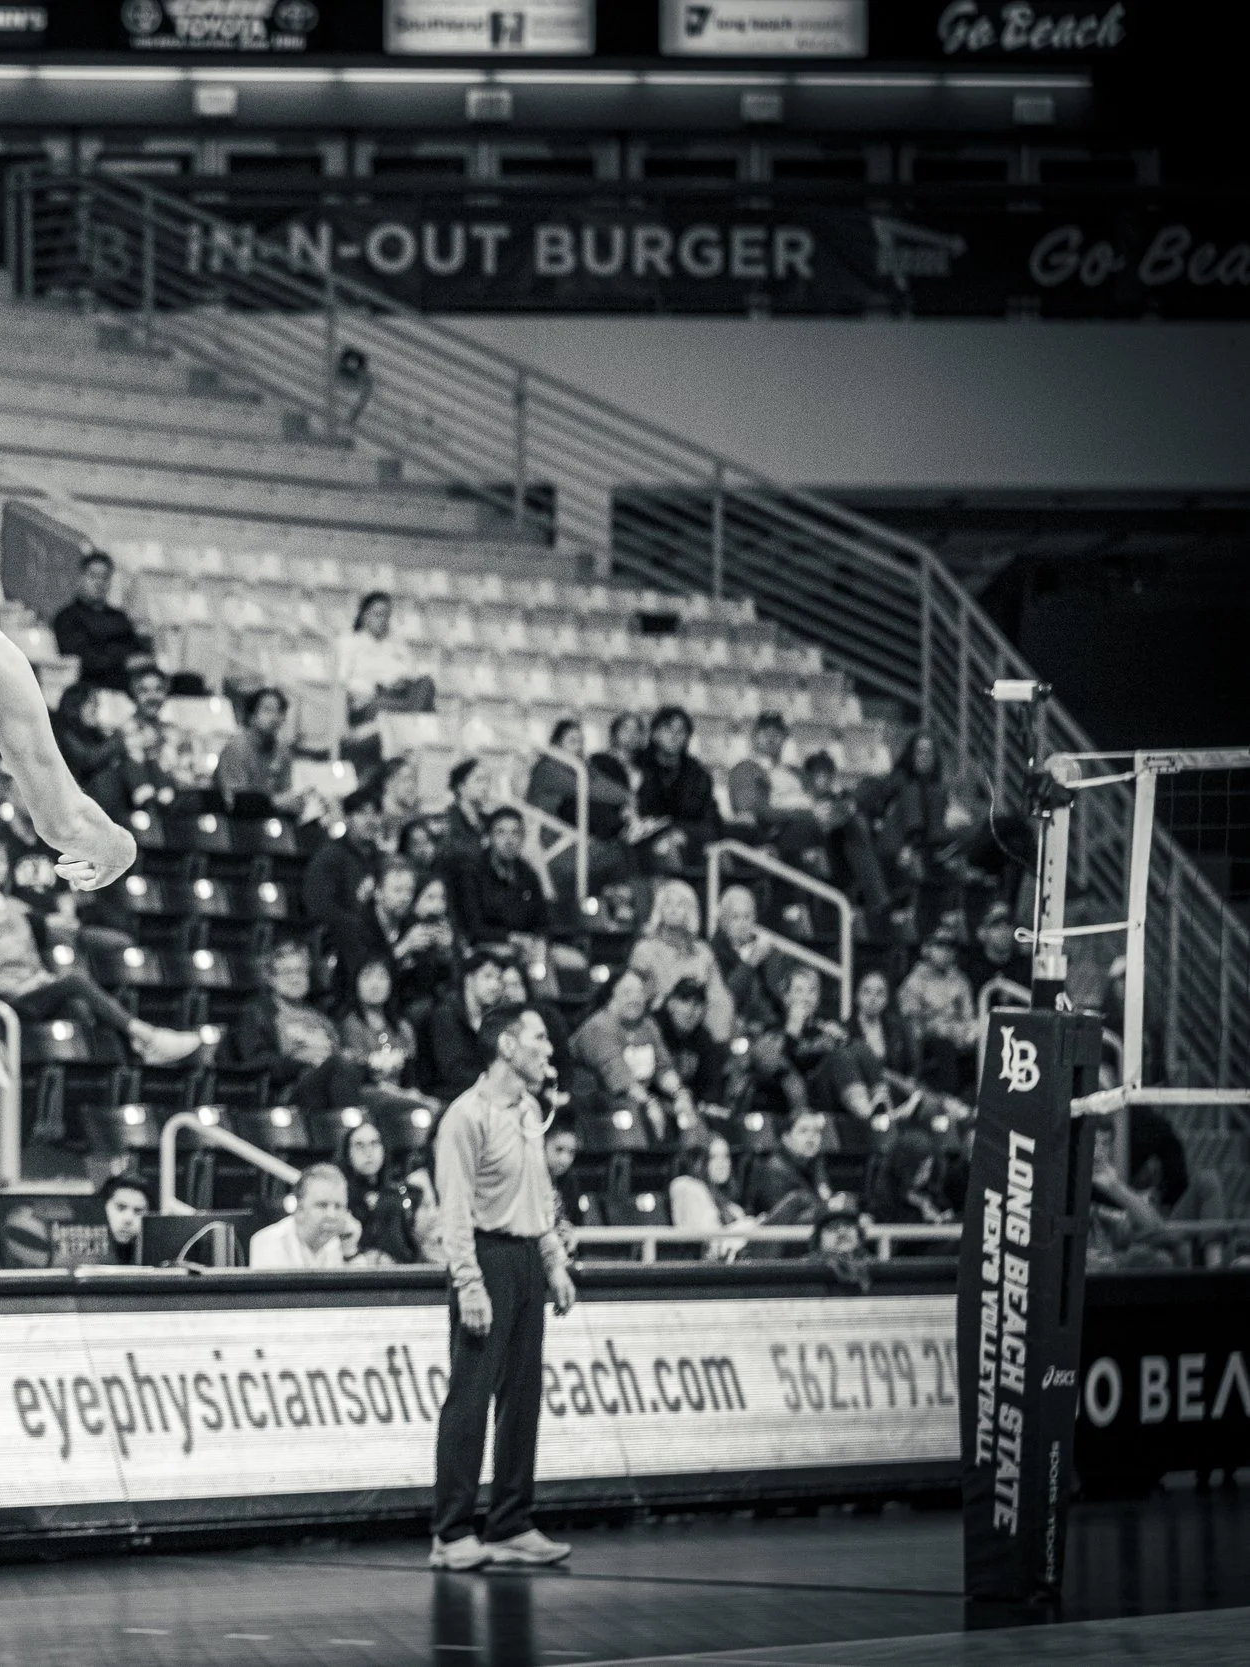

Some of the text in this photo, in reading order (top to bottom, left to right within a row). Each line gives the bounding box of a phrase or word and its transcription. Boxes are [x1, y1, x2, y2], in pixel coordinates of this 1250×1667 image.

[938, 1, 1127, 54] Go Beach
[188, 222, 511, 277] IN-N-OUT
[533, 222, 816, 278] BURGER
[1029, 223, 1125, 287] Go
[975, 1188, 1003, 1468] MEN'S VOLLEYBALL
[993, 1129, 1035, 1537] LONG BEACH STATE
[13, 1338, 747, 1461] eyephysiciansofloeach.com
[1075, 1355, 1123, 1429] O
